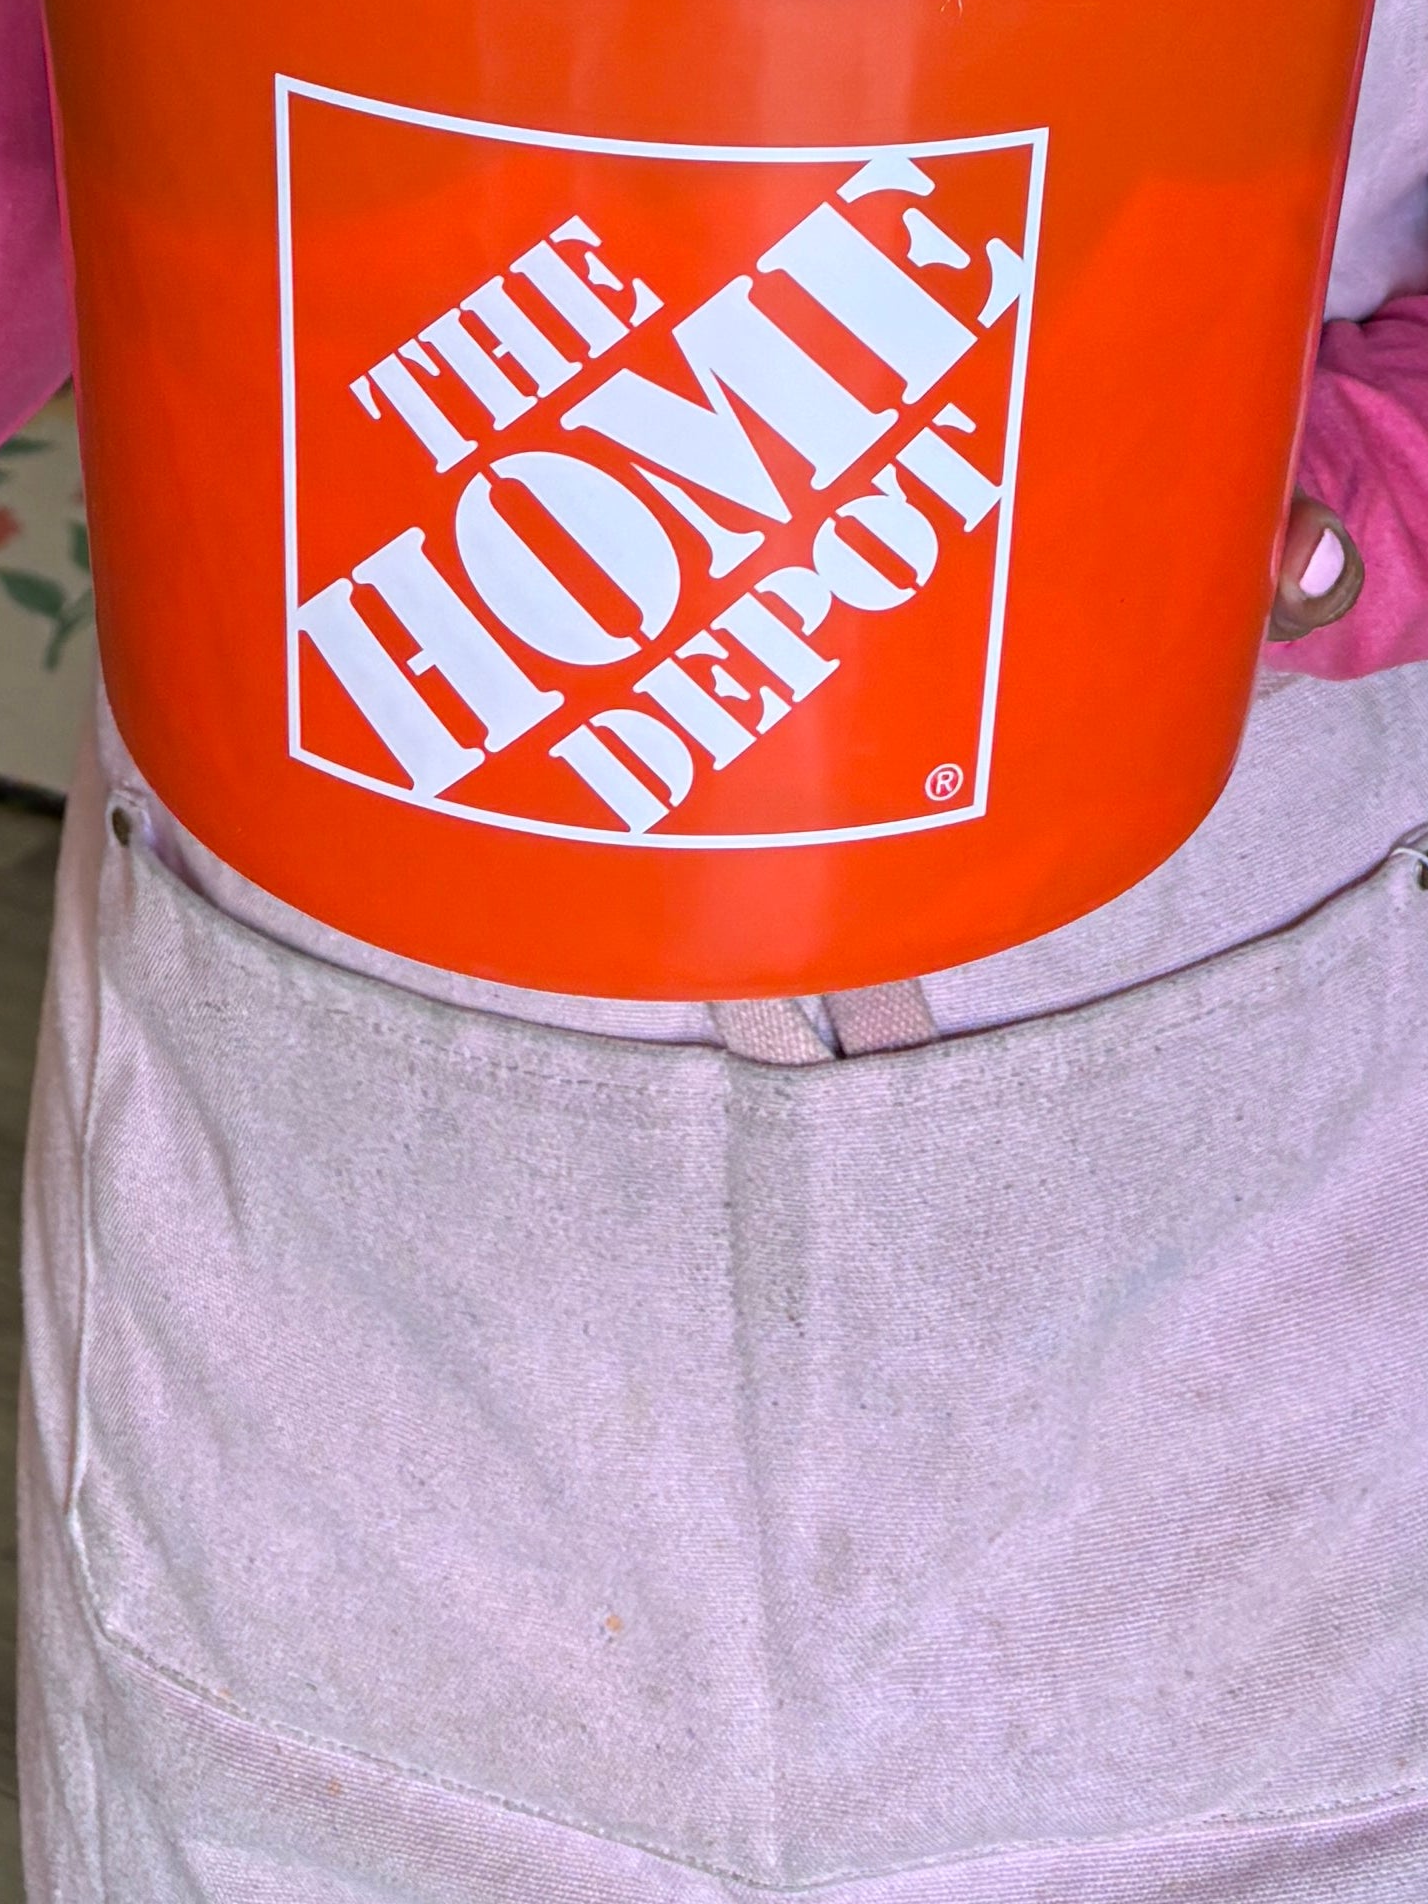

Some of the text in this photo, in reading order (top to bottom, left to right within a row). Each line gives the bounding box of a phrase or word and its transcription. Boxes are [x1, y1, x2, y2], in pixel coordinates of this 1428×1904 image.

[294, 155, 1025, 798] HOME
[349, 215, 664, 474] THE
[549, 402, 1004, 835] DEPOT
